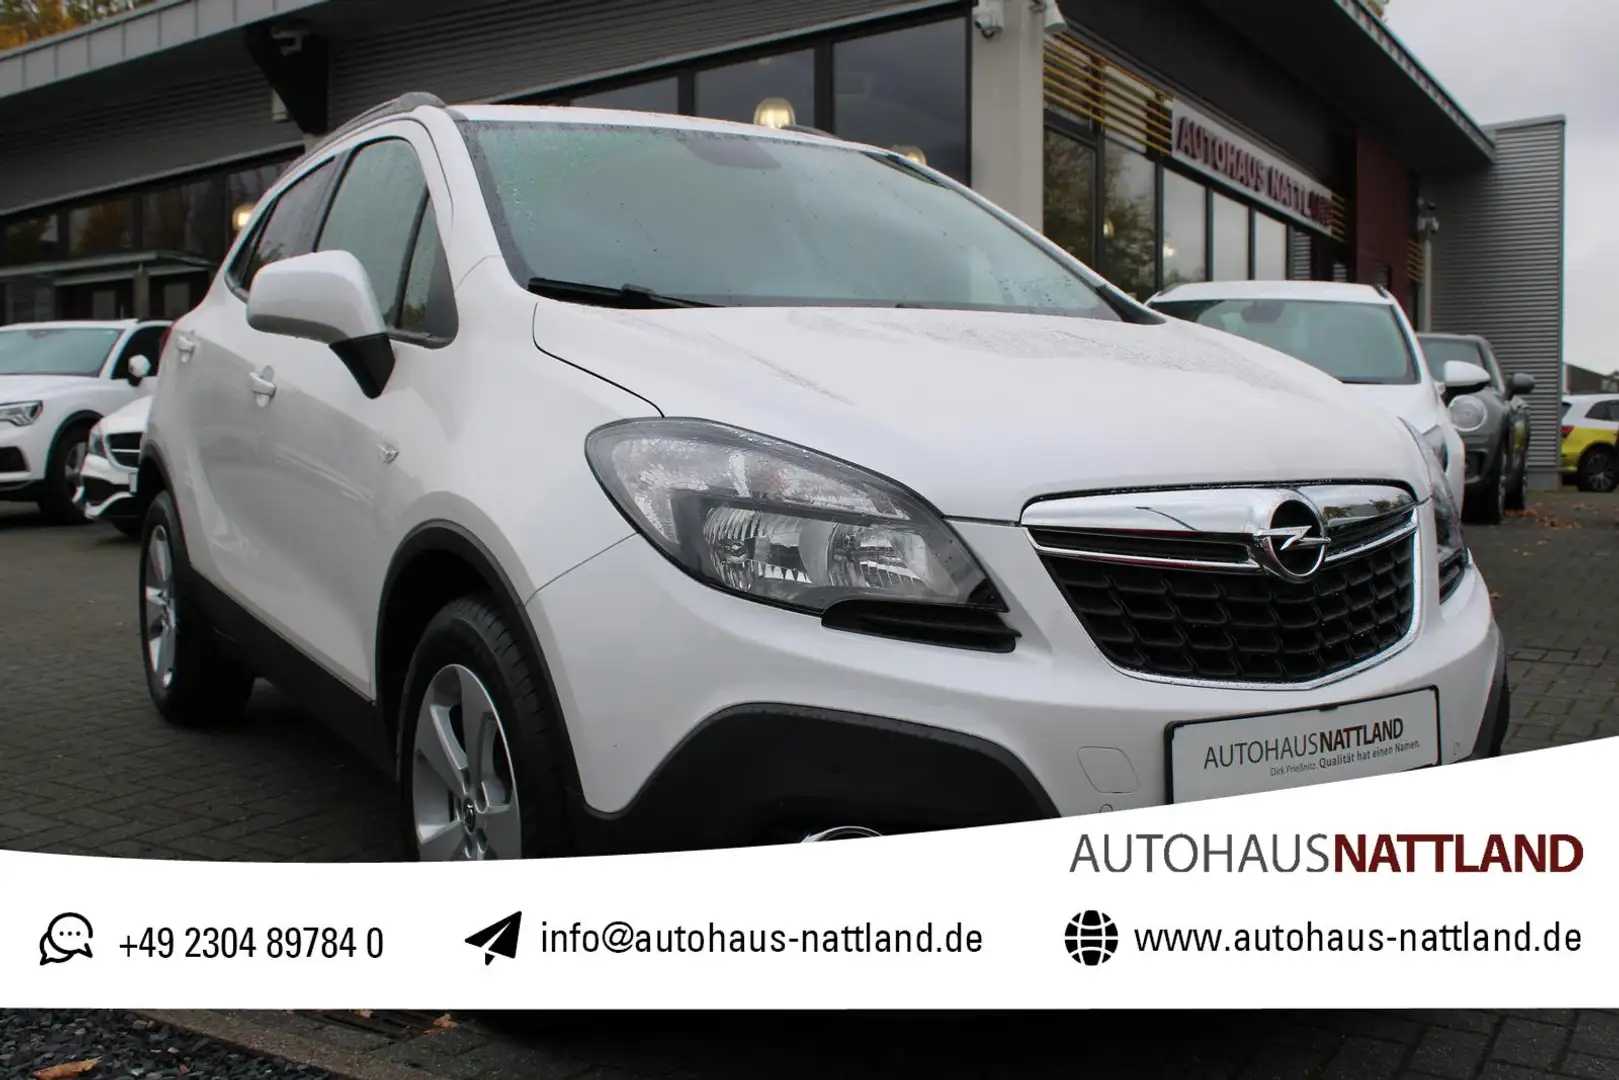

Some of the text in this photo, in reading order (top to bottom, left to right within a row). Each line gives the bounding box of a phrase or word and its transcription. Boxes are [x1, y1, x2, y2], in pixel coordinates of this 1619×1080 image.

[1177, 115, 1334, 229] AUTOHAUS NATTL
[1269, 765, 1286, 776] Dirk
[1319, 752, 1355, 769] Qualität
[1356, 750, 1371, 761] hat
[1372, 746, 1393, 759] einen
